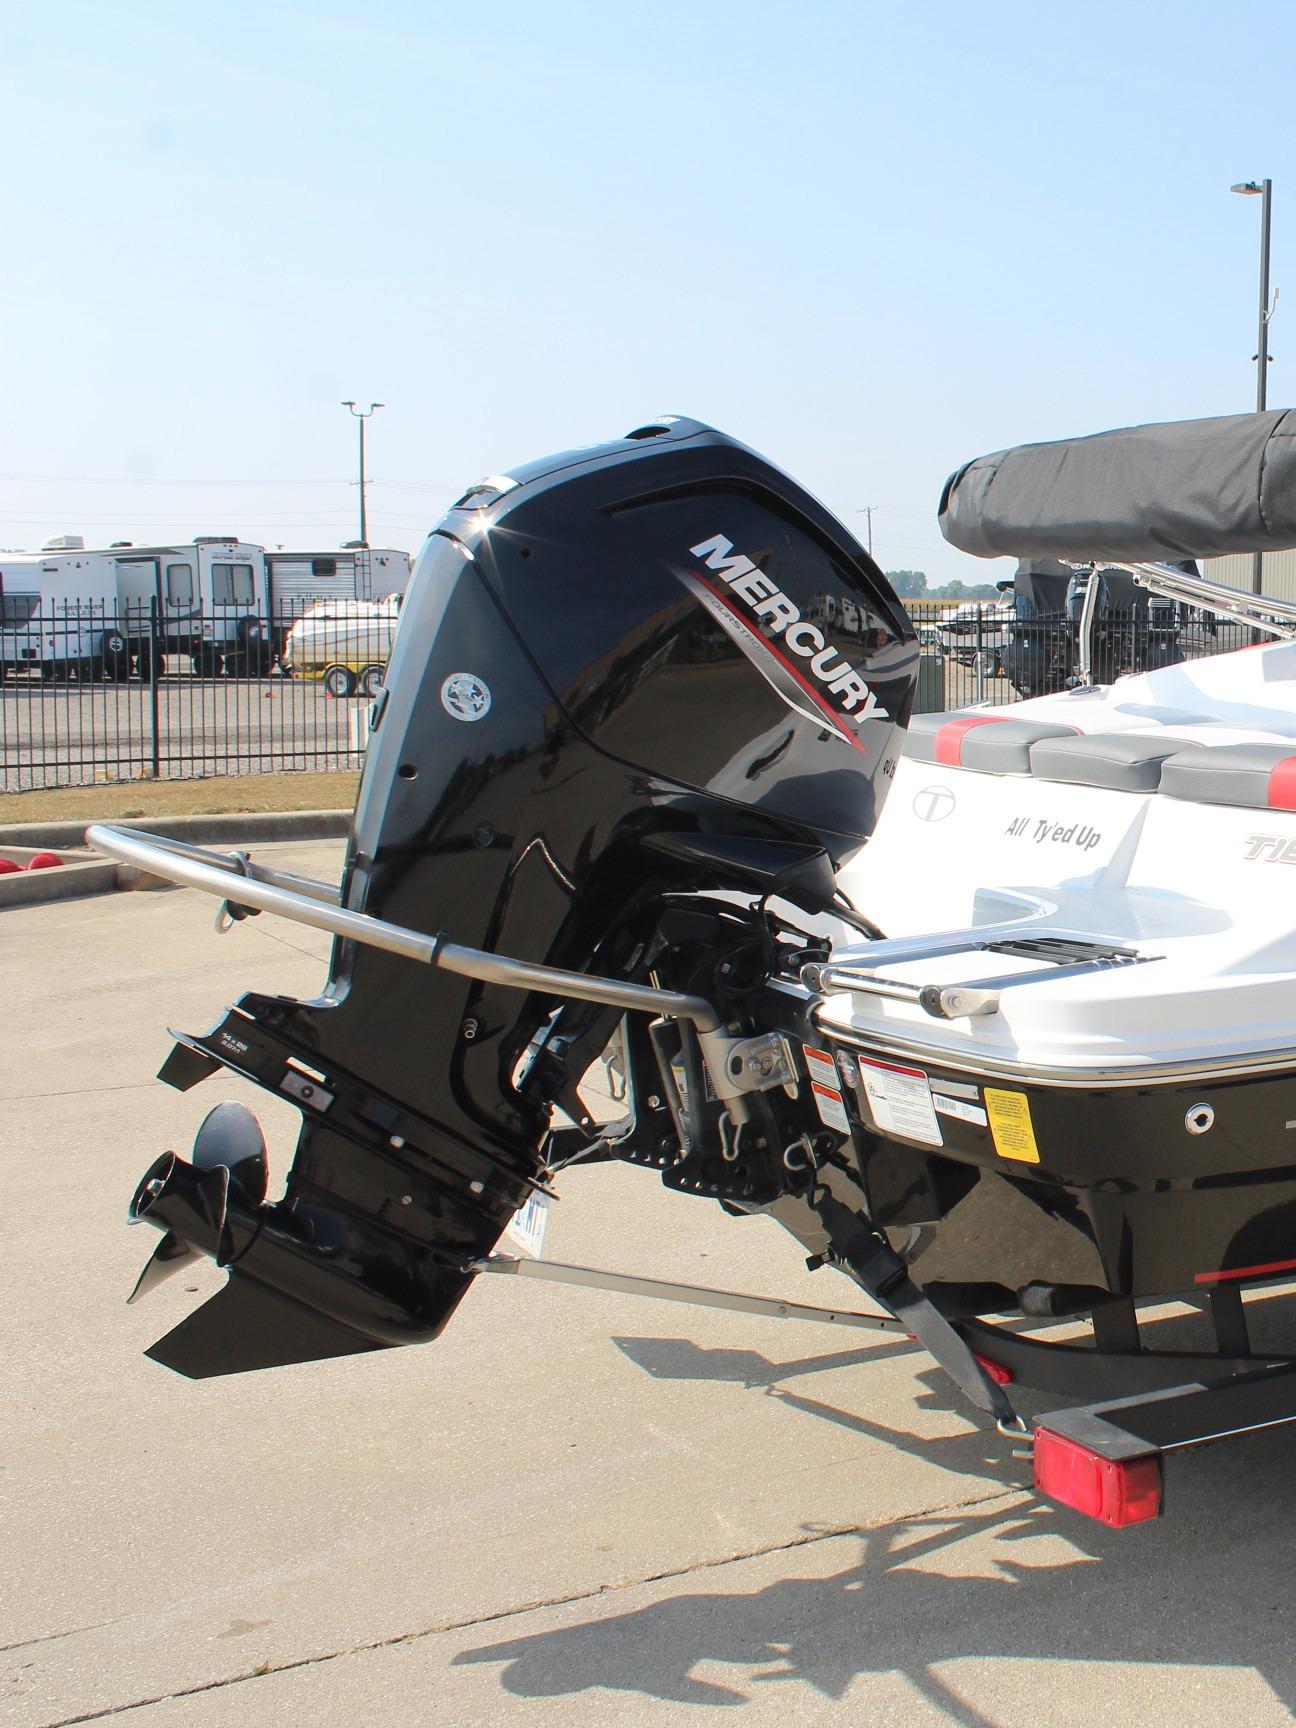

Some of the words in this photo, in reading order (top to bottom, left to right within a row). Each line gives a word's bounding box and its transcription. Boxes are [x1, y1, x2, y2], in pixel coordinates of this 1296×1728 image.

[689, 533, 890, 724] MERCURY
[1004, 817, 1031, 837] All
[1033, 819, 1079, 844] Ty'ed
[1075, 825, 1101, 851] Up
